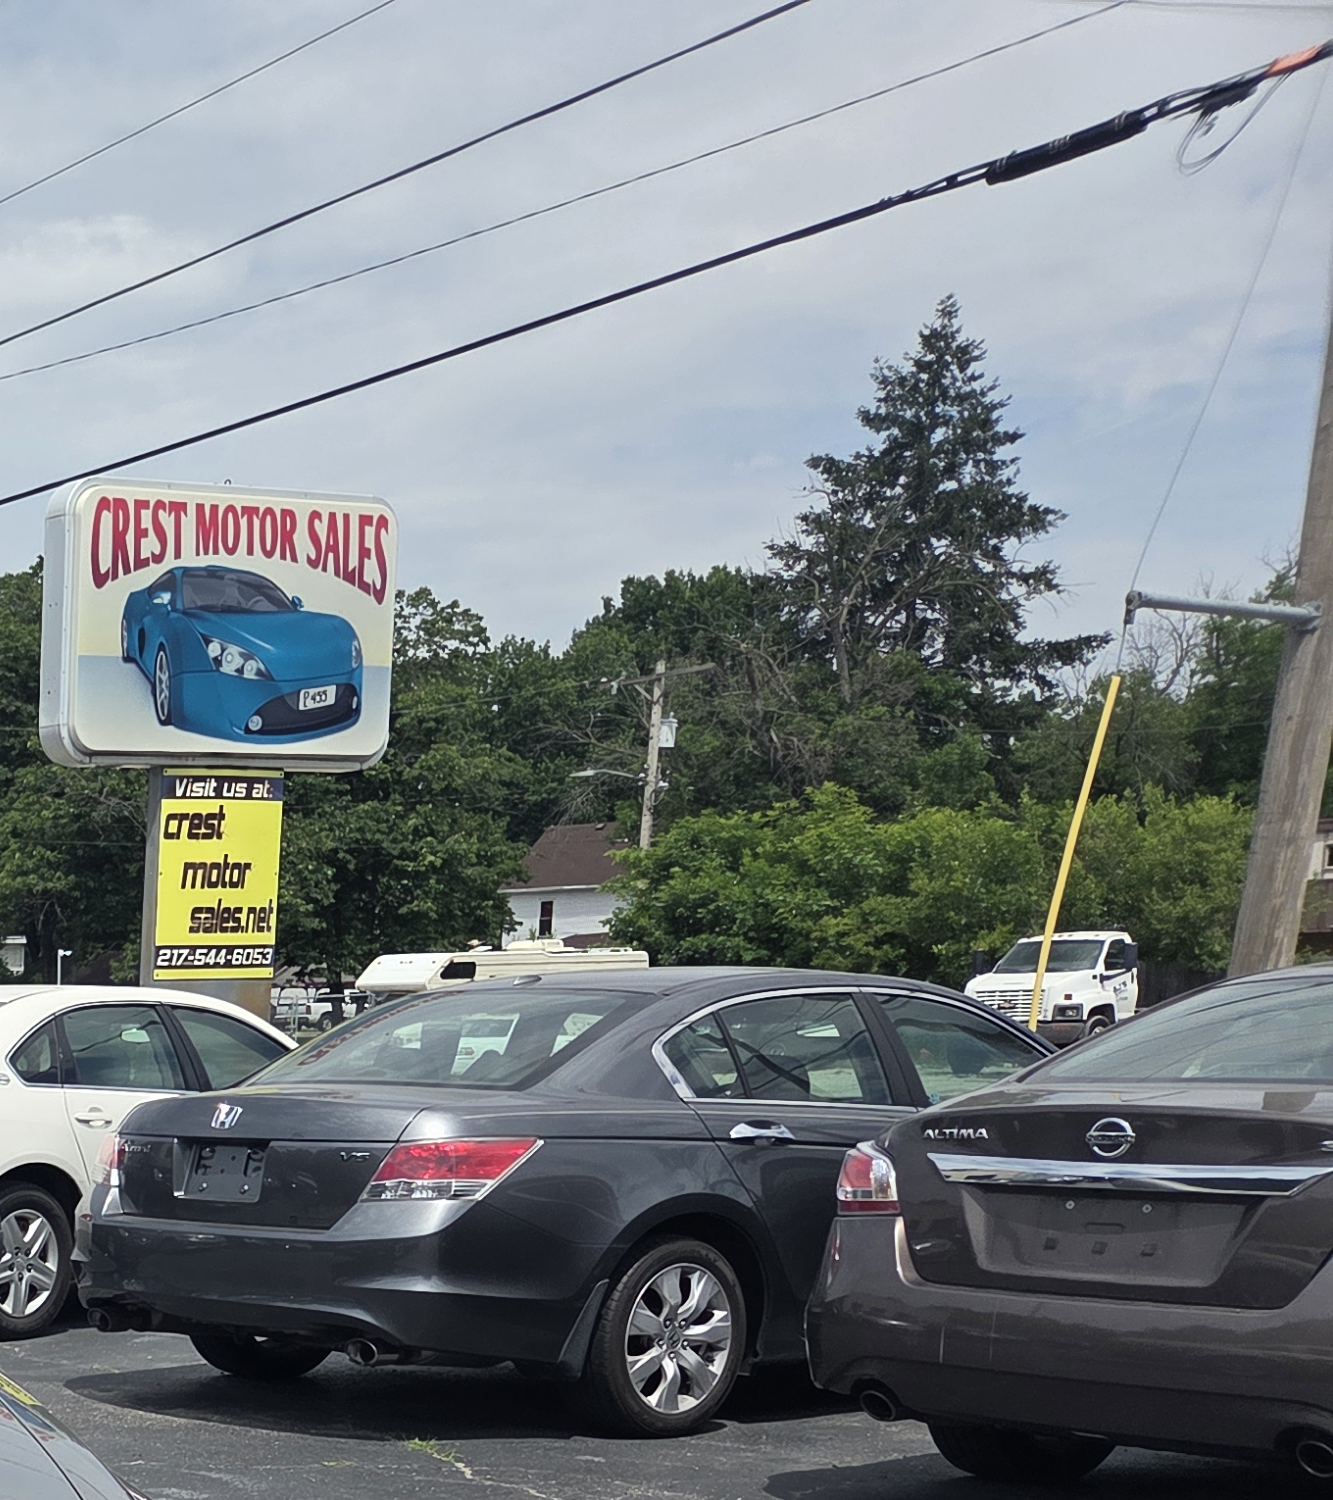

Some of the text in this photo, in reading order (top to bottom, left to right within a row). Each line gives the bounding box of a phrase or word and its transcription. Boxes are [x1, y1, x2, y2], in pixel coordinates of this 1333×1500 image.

[91, 496, 389, 606] CREST MOTOR SALES
[175, 778, 273, 798] Visit us at:
[163, 804, 226, 840] crest
[180, 853, 252, 889] motor
[188, 898, 274, 934] sales.net
[156, 948, 273, 966] 217-544-6053
[923, 1128, 989, 1139] ALTIMA
